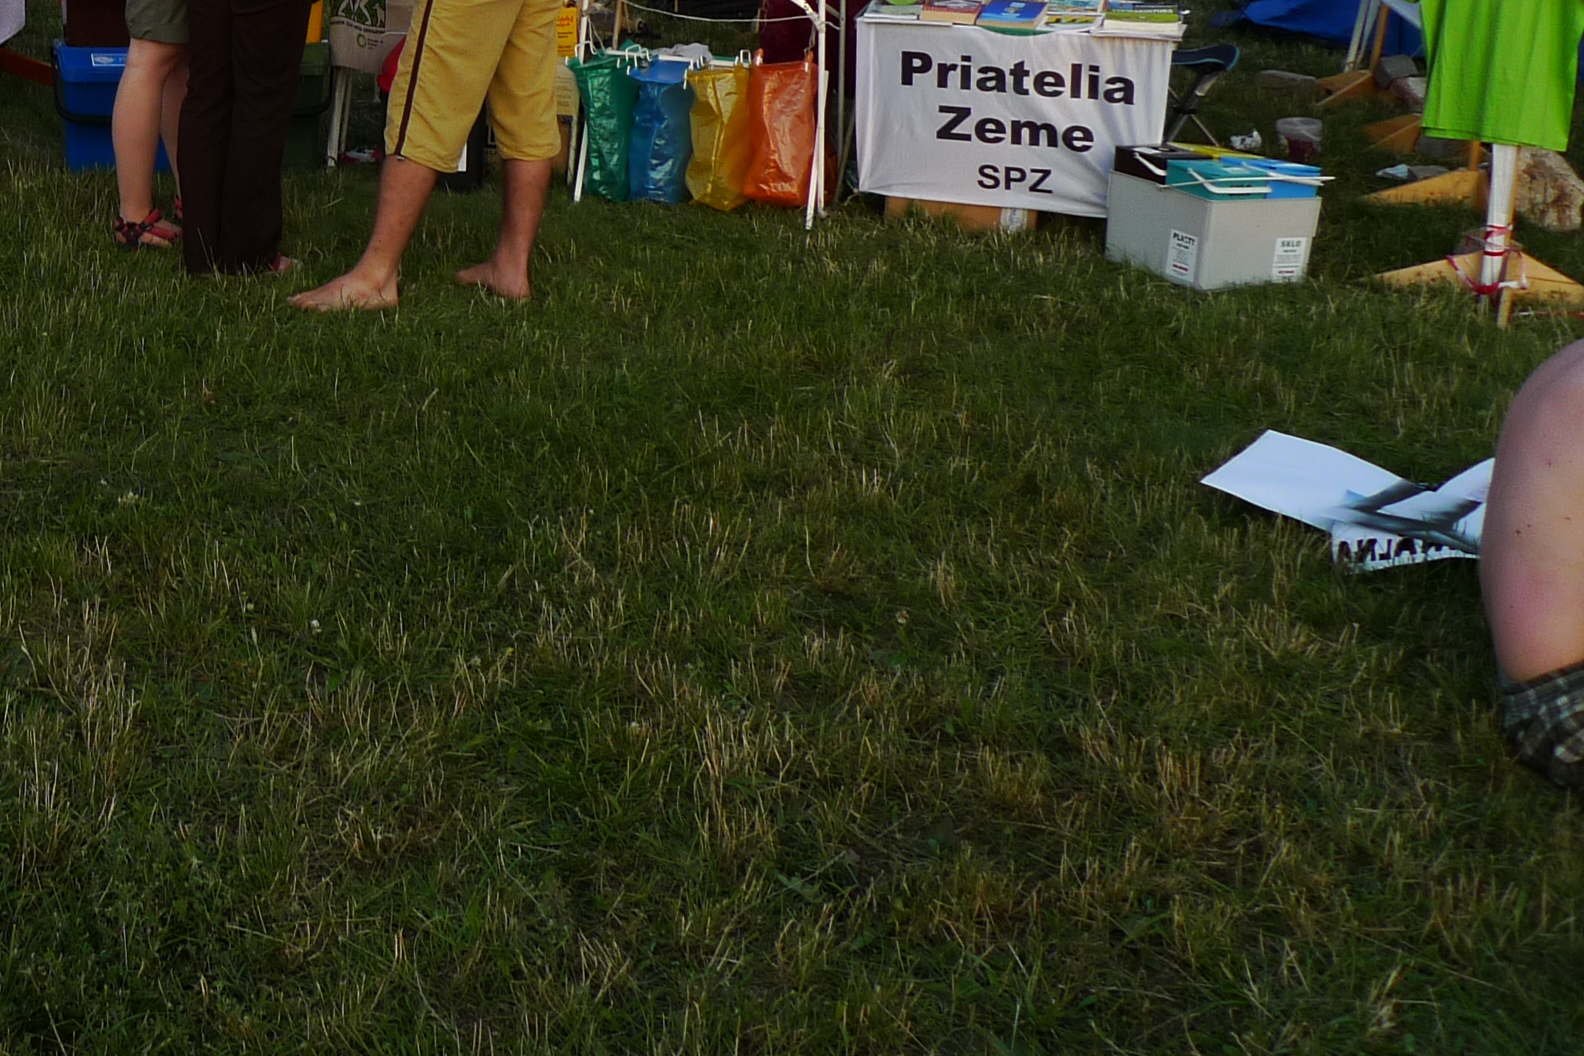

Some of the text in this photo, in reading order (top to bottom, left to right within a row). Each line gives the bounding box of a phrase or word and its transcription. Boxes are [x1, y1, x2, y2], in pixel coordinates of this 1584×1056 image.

[901, 51, 1135, 105] Priatelia
[936, 105, 1095, 153] Zeme
[977, 164, 1053, 194] SPZ
